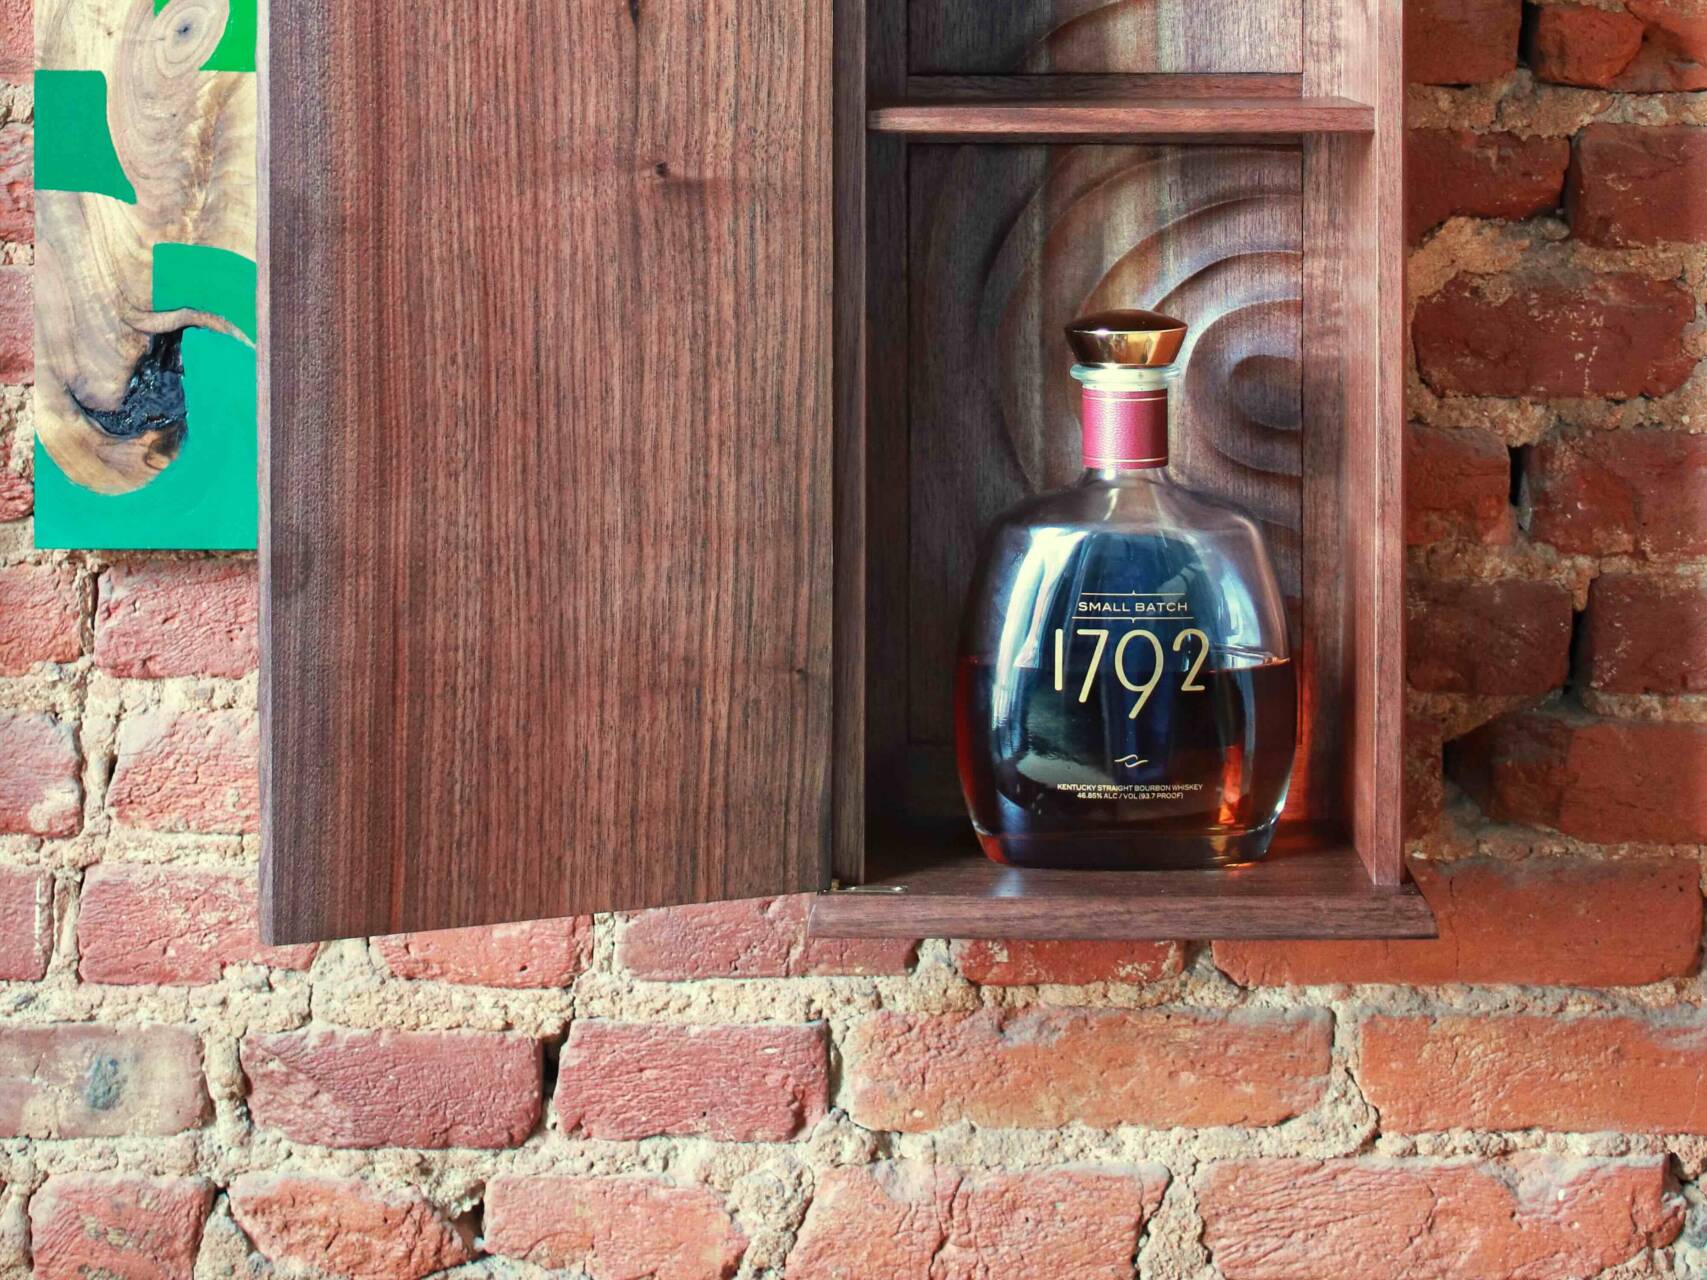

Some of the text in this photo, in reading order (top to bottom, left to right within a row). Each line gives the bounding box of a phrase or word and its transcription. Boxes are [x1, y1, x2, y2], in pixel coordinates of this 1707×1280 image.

[1078, 602, 1188, 612] SMALL BATCH
[1054, 628, 1210, 720] 1792
[1097, 784, 1133, 792] STRAIGHT
[1134, 784, 1170, 792] BOURBON
[1171, 783, 1203, 791] WHISKEY
[1138, 792, 1156, 800] (93.7
[1156, 791, 1184, 800] PROOF)
